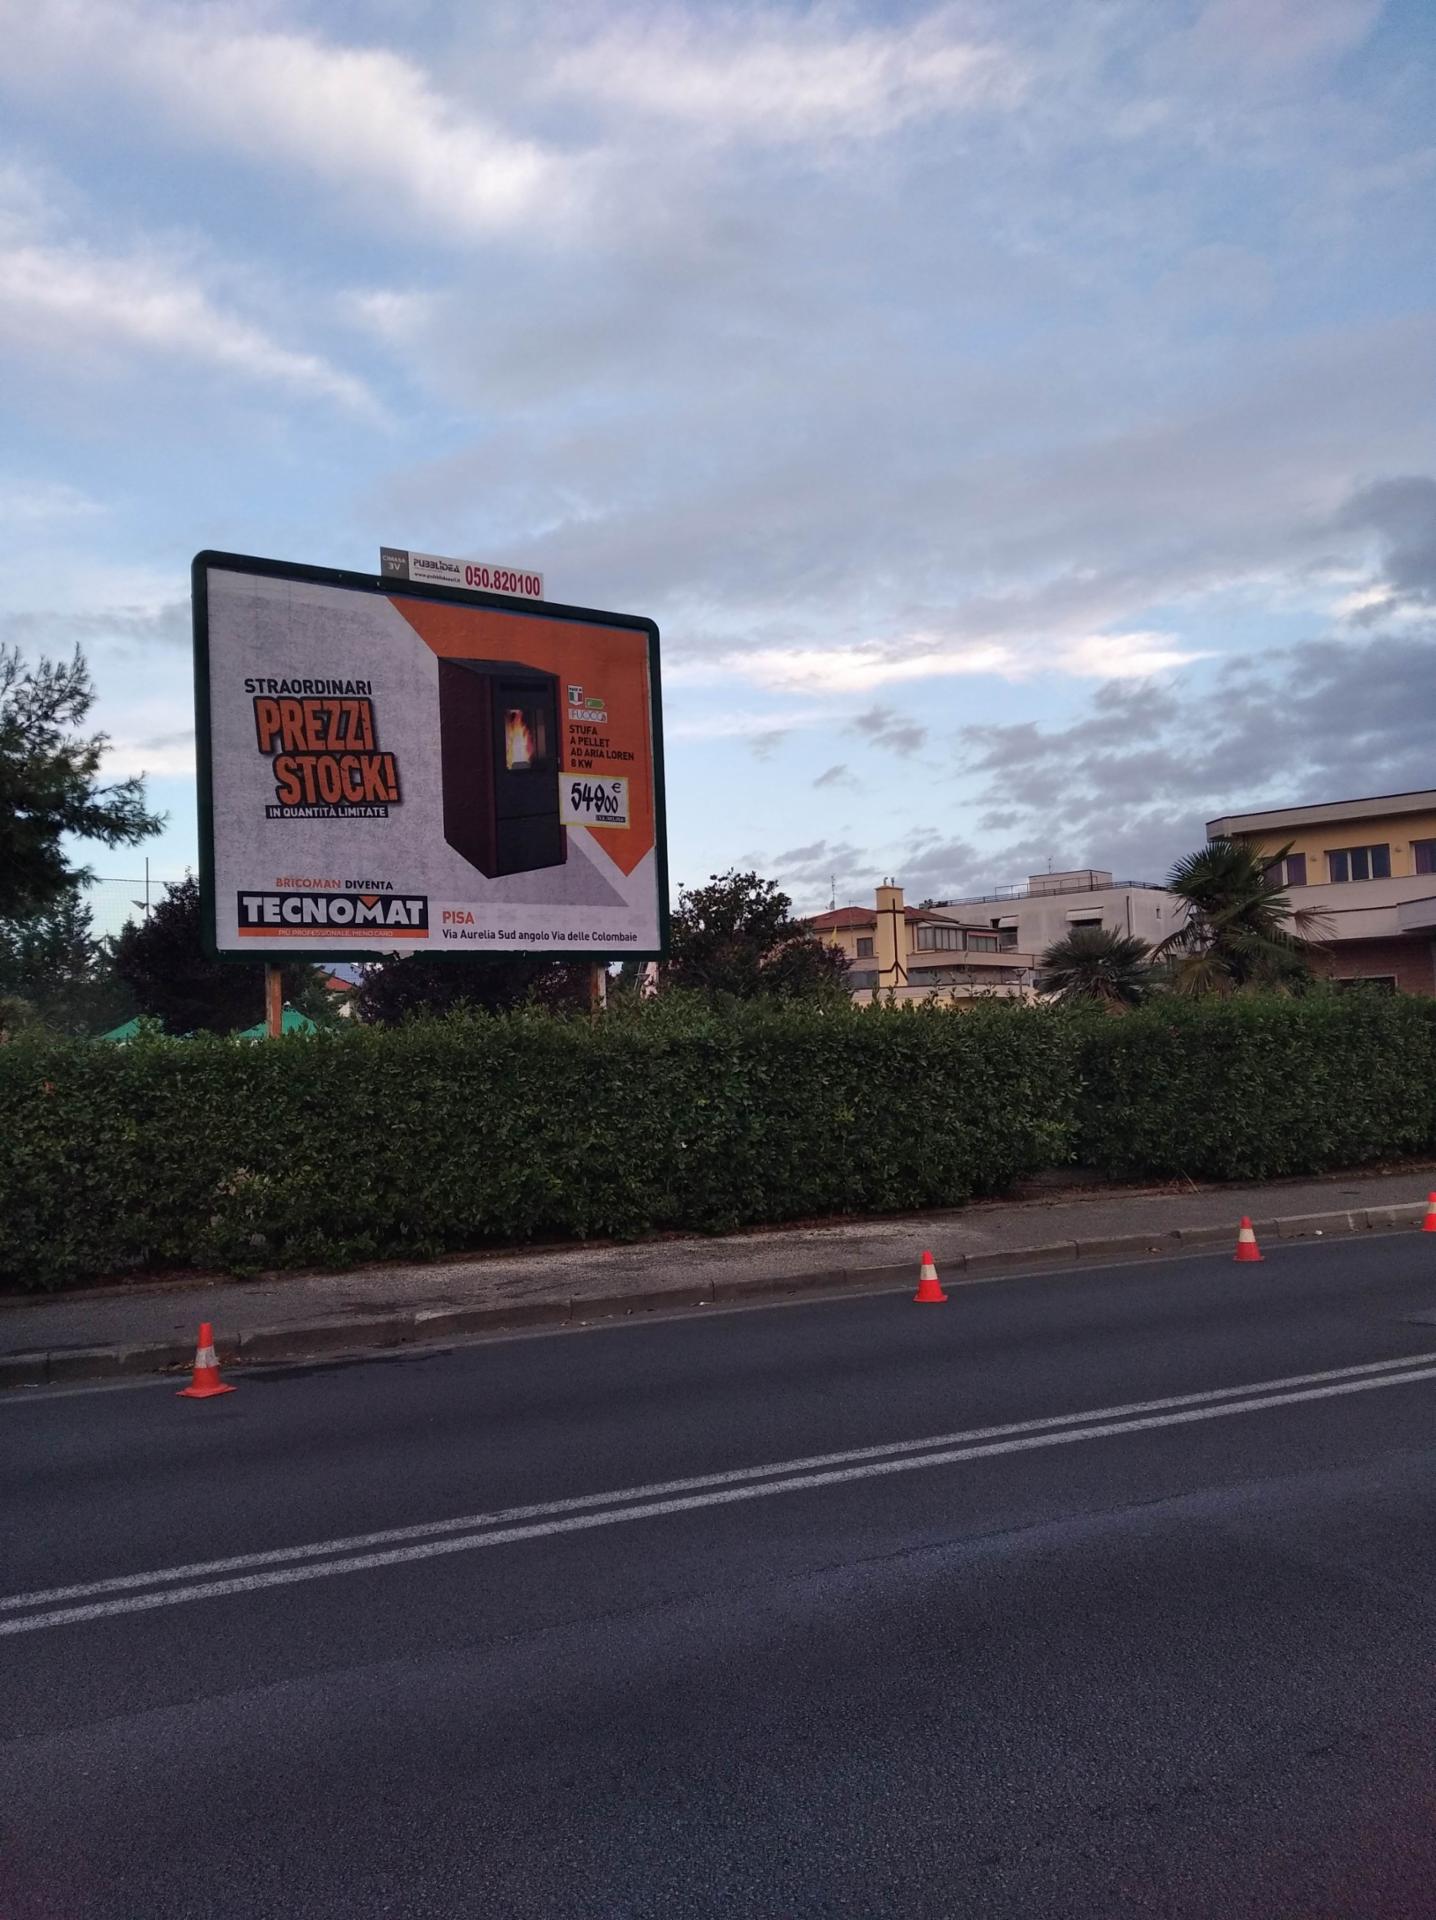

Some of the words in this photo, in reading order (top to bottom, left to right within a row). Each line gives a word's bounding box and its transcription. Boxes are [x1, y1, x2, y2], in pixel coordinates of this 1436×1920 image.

[388, 563, 400, 571] 3V
[465, 565, 540, 596] 050.820100
[244, 679, 372, 695] STRAORDINARI
[254, 698, 374, 752] PREZZI
[569, 725, 597, 735] STUFA
[570, 737, 575, 745] A
[578, 737, 609, 747] PELLET
[570, 748, 583, 756] AD
[584, 749, 604, 758] ARIA
[606, 751, 634, 761] LOREN
[571, 759, 576, 767] 8
[578, 760, 592, 768] KW
[275, 754, 398, 804] STOCK!
[269, 808, 281, 817] IN
[283, 805, 335, 817] QUANTITÀ
[338, 807, 386, 817] LIMITATE
[275, 878, 341, 889] BRICOMAN
[345, 879, 393, 890] DIVENTA
[243, 896, 423, 925] TECNOMAT
[442, 911, 475, 924] PISA
[442, 929, 458, 939] Via
[460, 930, 495, 939] Aurelia
[498, 930, 516, 940] Sud
[518, 931, 549, 942] angolo
[551, 931, 565, 940] Via
[568, 931, 590, 941] delle
[592, 932, 637, 942] Colombaie
